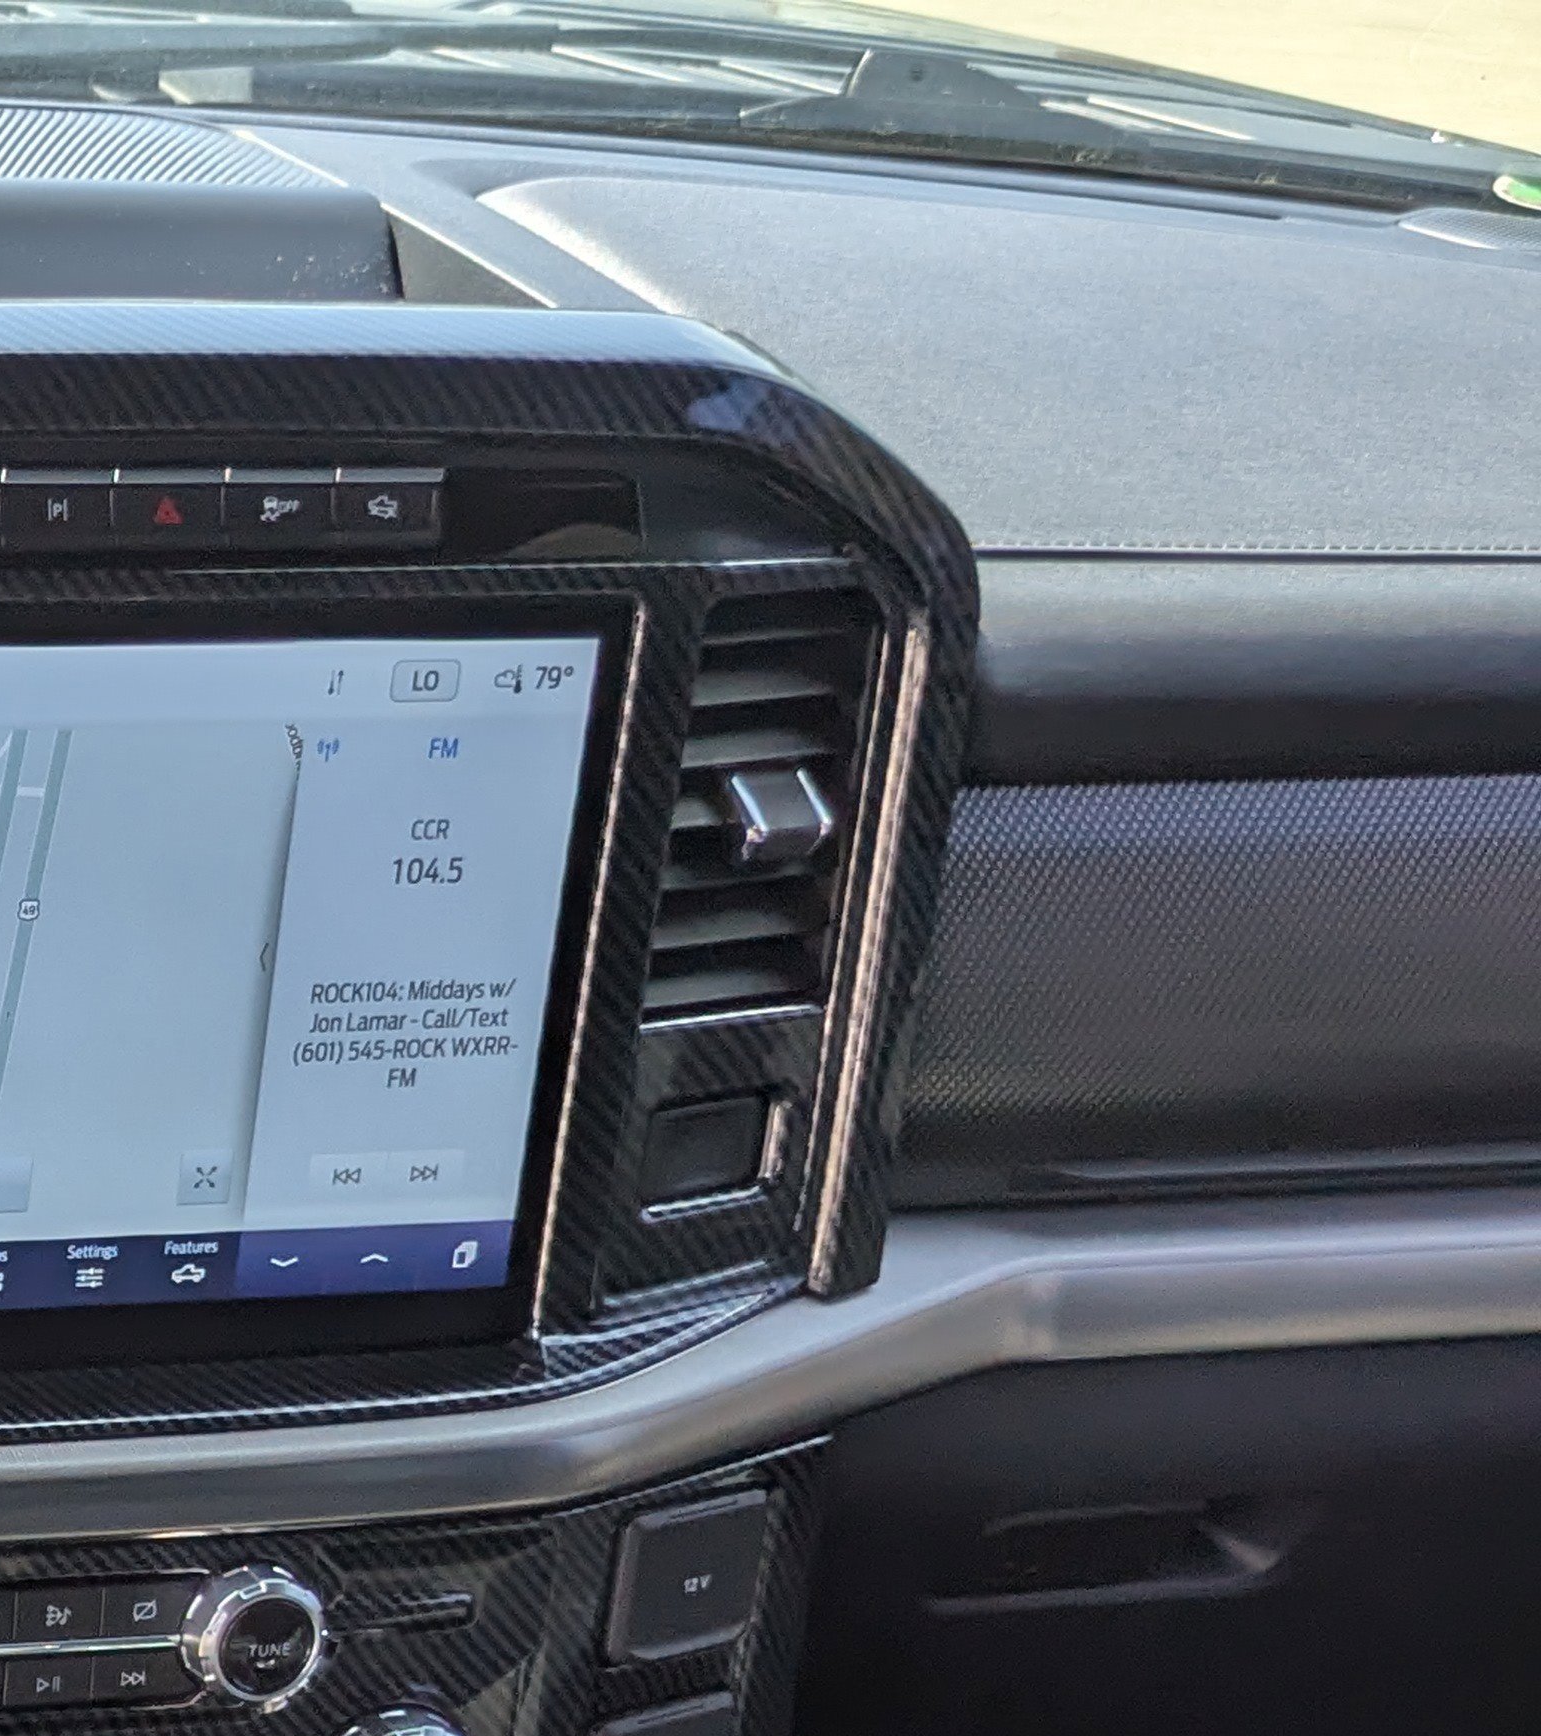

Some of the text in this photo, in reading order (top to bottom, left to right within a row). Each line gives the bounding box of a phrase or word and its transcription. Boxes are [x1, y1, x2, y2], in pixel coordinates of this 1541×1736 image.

[412, 671, 439, 691] LO
[535, 665, 574, 690] 79°
[428, 738, 459, 759] FM
[411, 819, 450, 841] CCR
[393, 857, 463, 885] 104.5
[311, 978, 517, 1004] ROCK104: Middays w/
[309, 1013, 342, 1033] Jon
[346, 1012, 408, 1032] Lamar
[422, 1007, 508, 1030] Call/Text
[293, 1035, 519, 1066] (601) 545-ROCK WXRR-
[386, 1067, 417, 1089] FM
[67, 1243, 118, 1262] Settings
[163, 1239, 218, 1257] Features
[248, 1641, 291, 1658] TUNE
